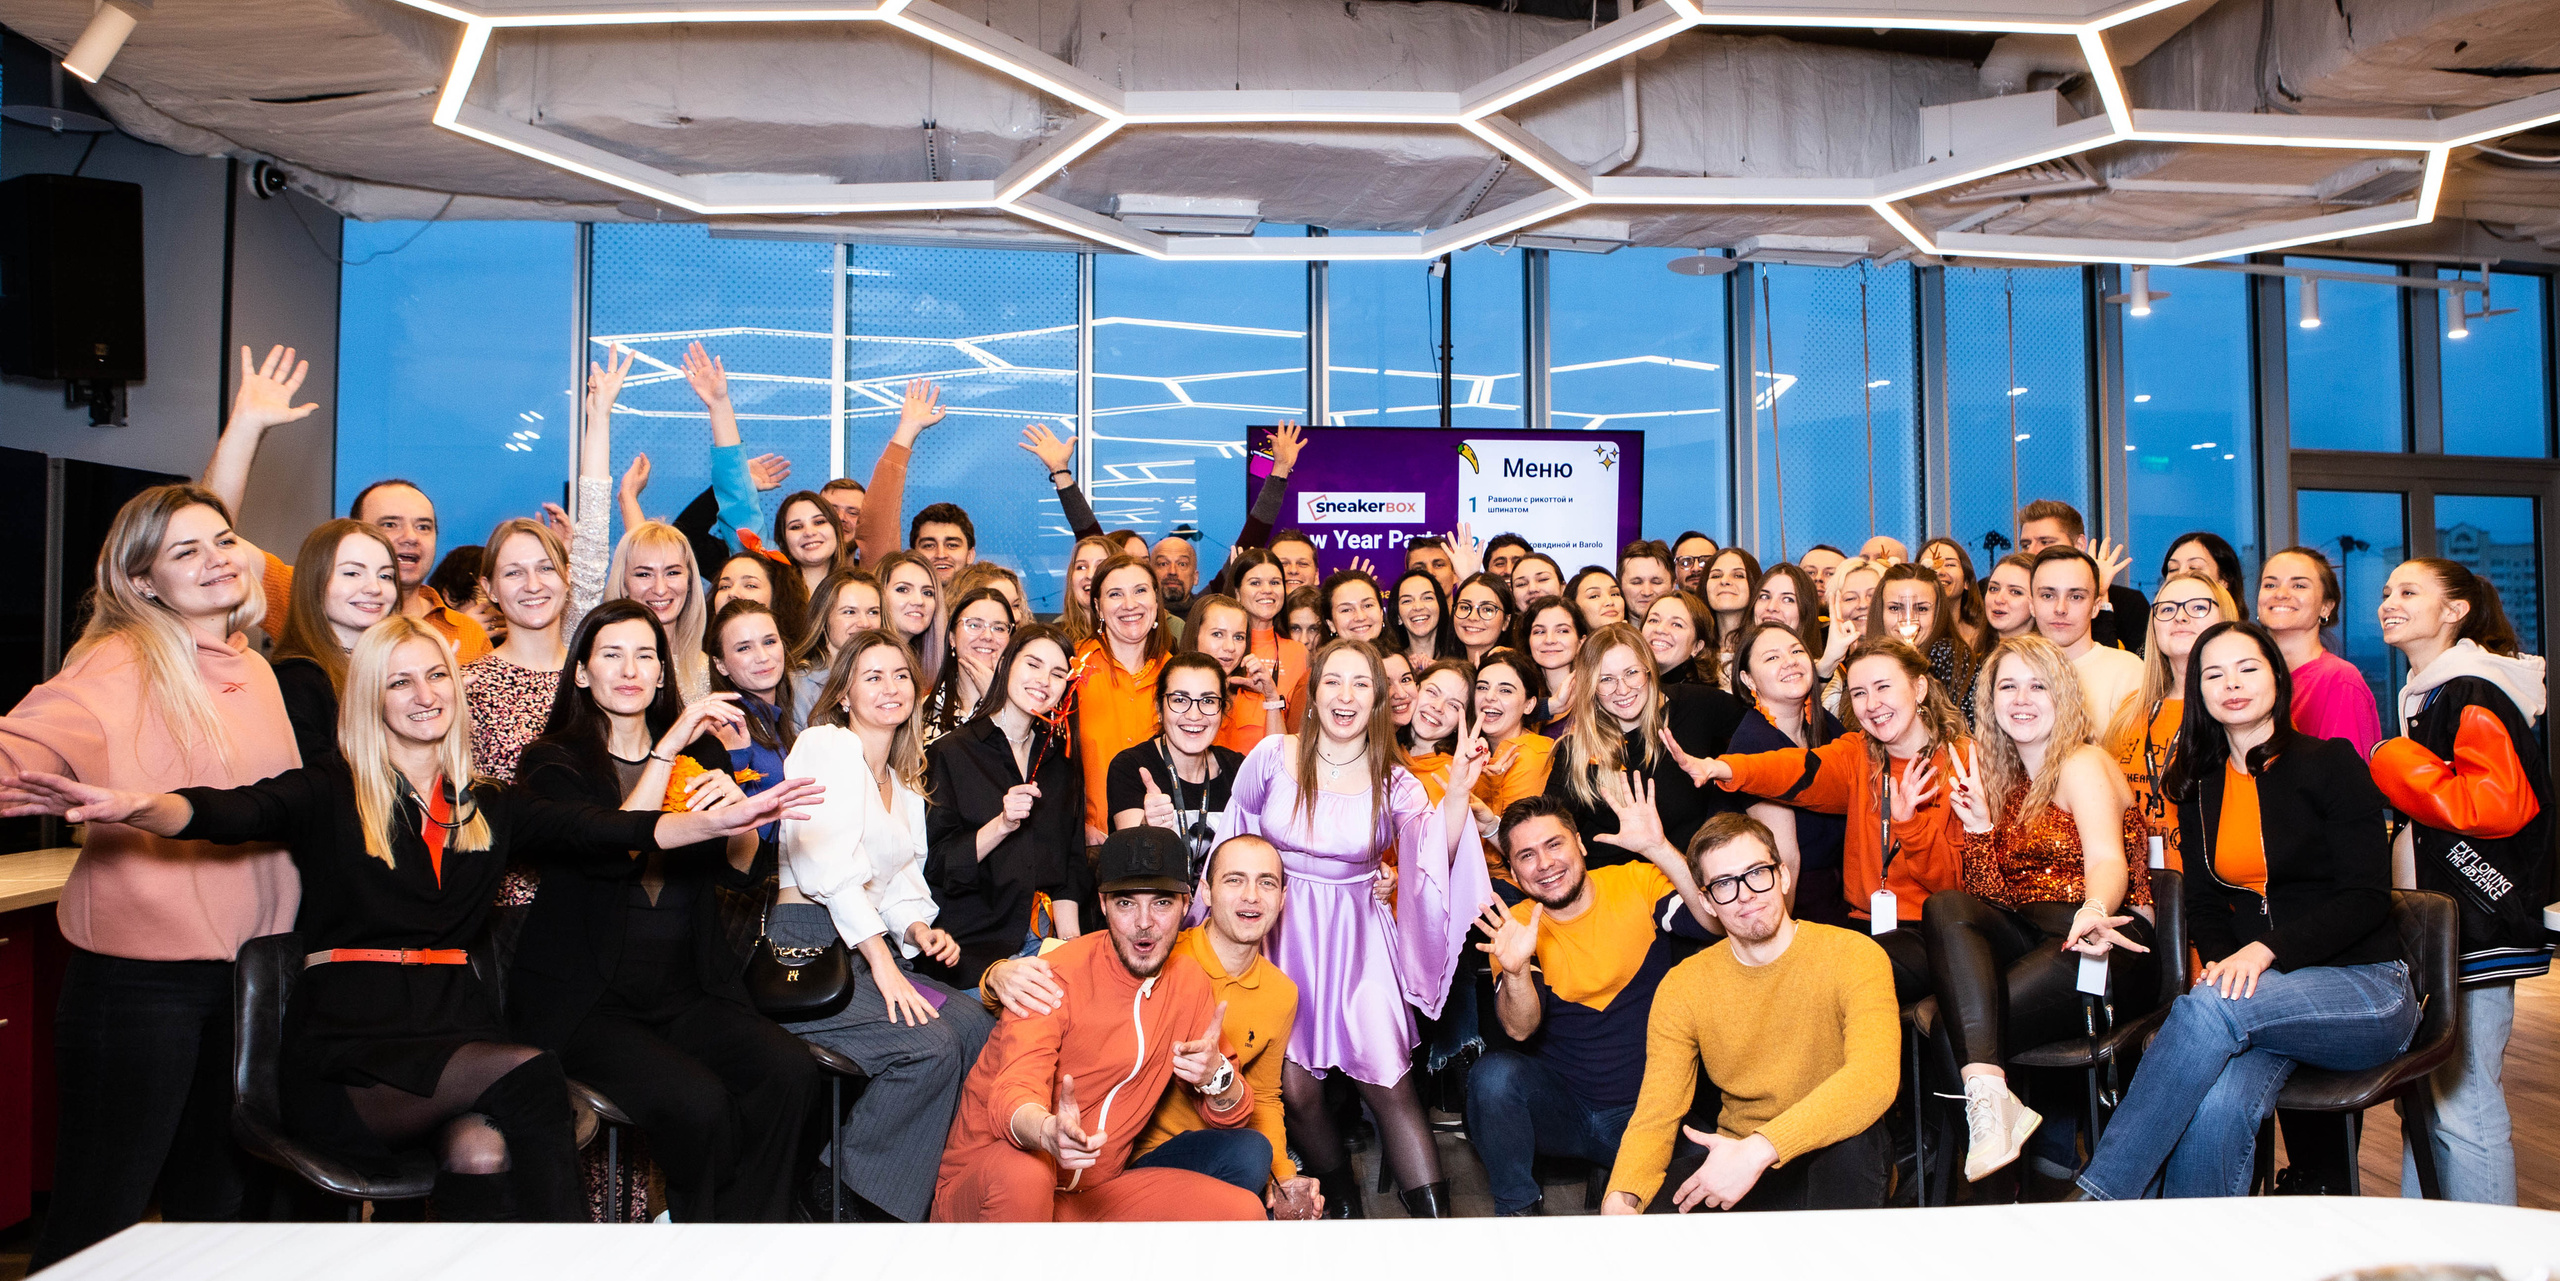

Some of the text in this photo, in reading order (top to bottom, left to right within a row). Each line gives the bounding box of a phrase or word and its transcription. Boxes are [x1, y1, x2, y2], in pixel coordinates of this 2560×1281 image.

[1503, 457, 1573, 478] Меню
[1315, 498, 1417, 514] sneakerBOX
[1468, 496, 1477, 513] 1
[1487, 495, 1522, 503] Равиоли
[1529, 495, 1567, 505] рикоттой
[1332, 529, 1383, 549] Year
[2446, 848, 2503, 901] THE ABSENCE
[2453, 840, 2514, 894] EXPLORING
